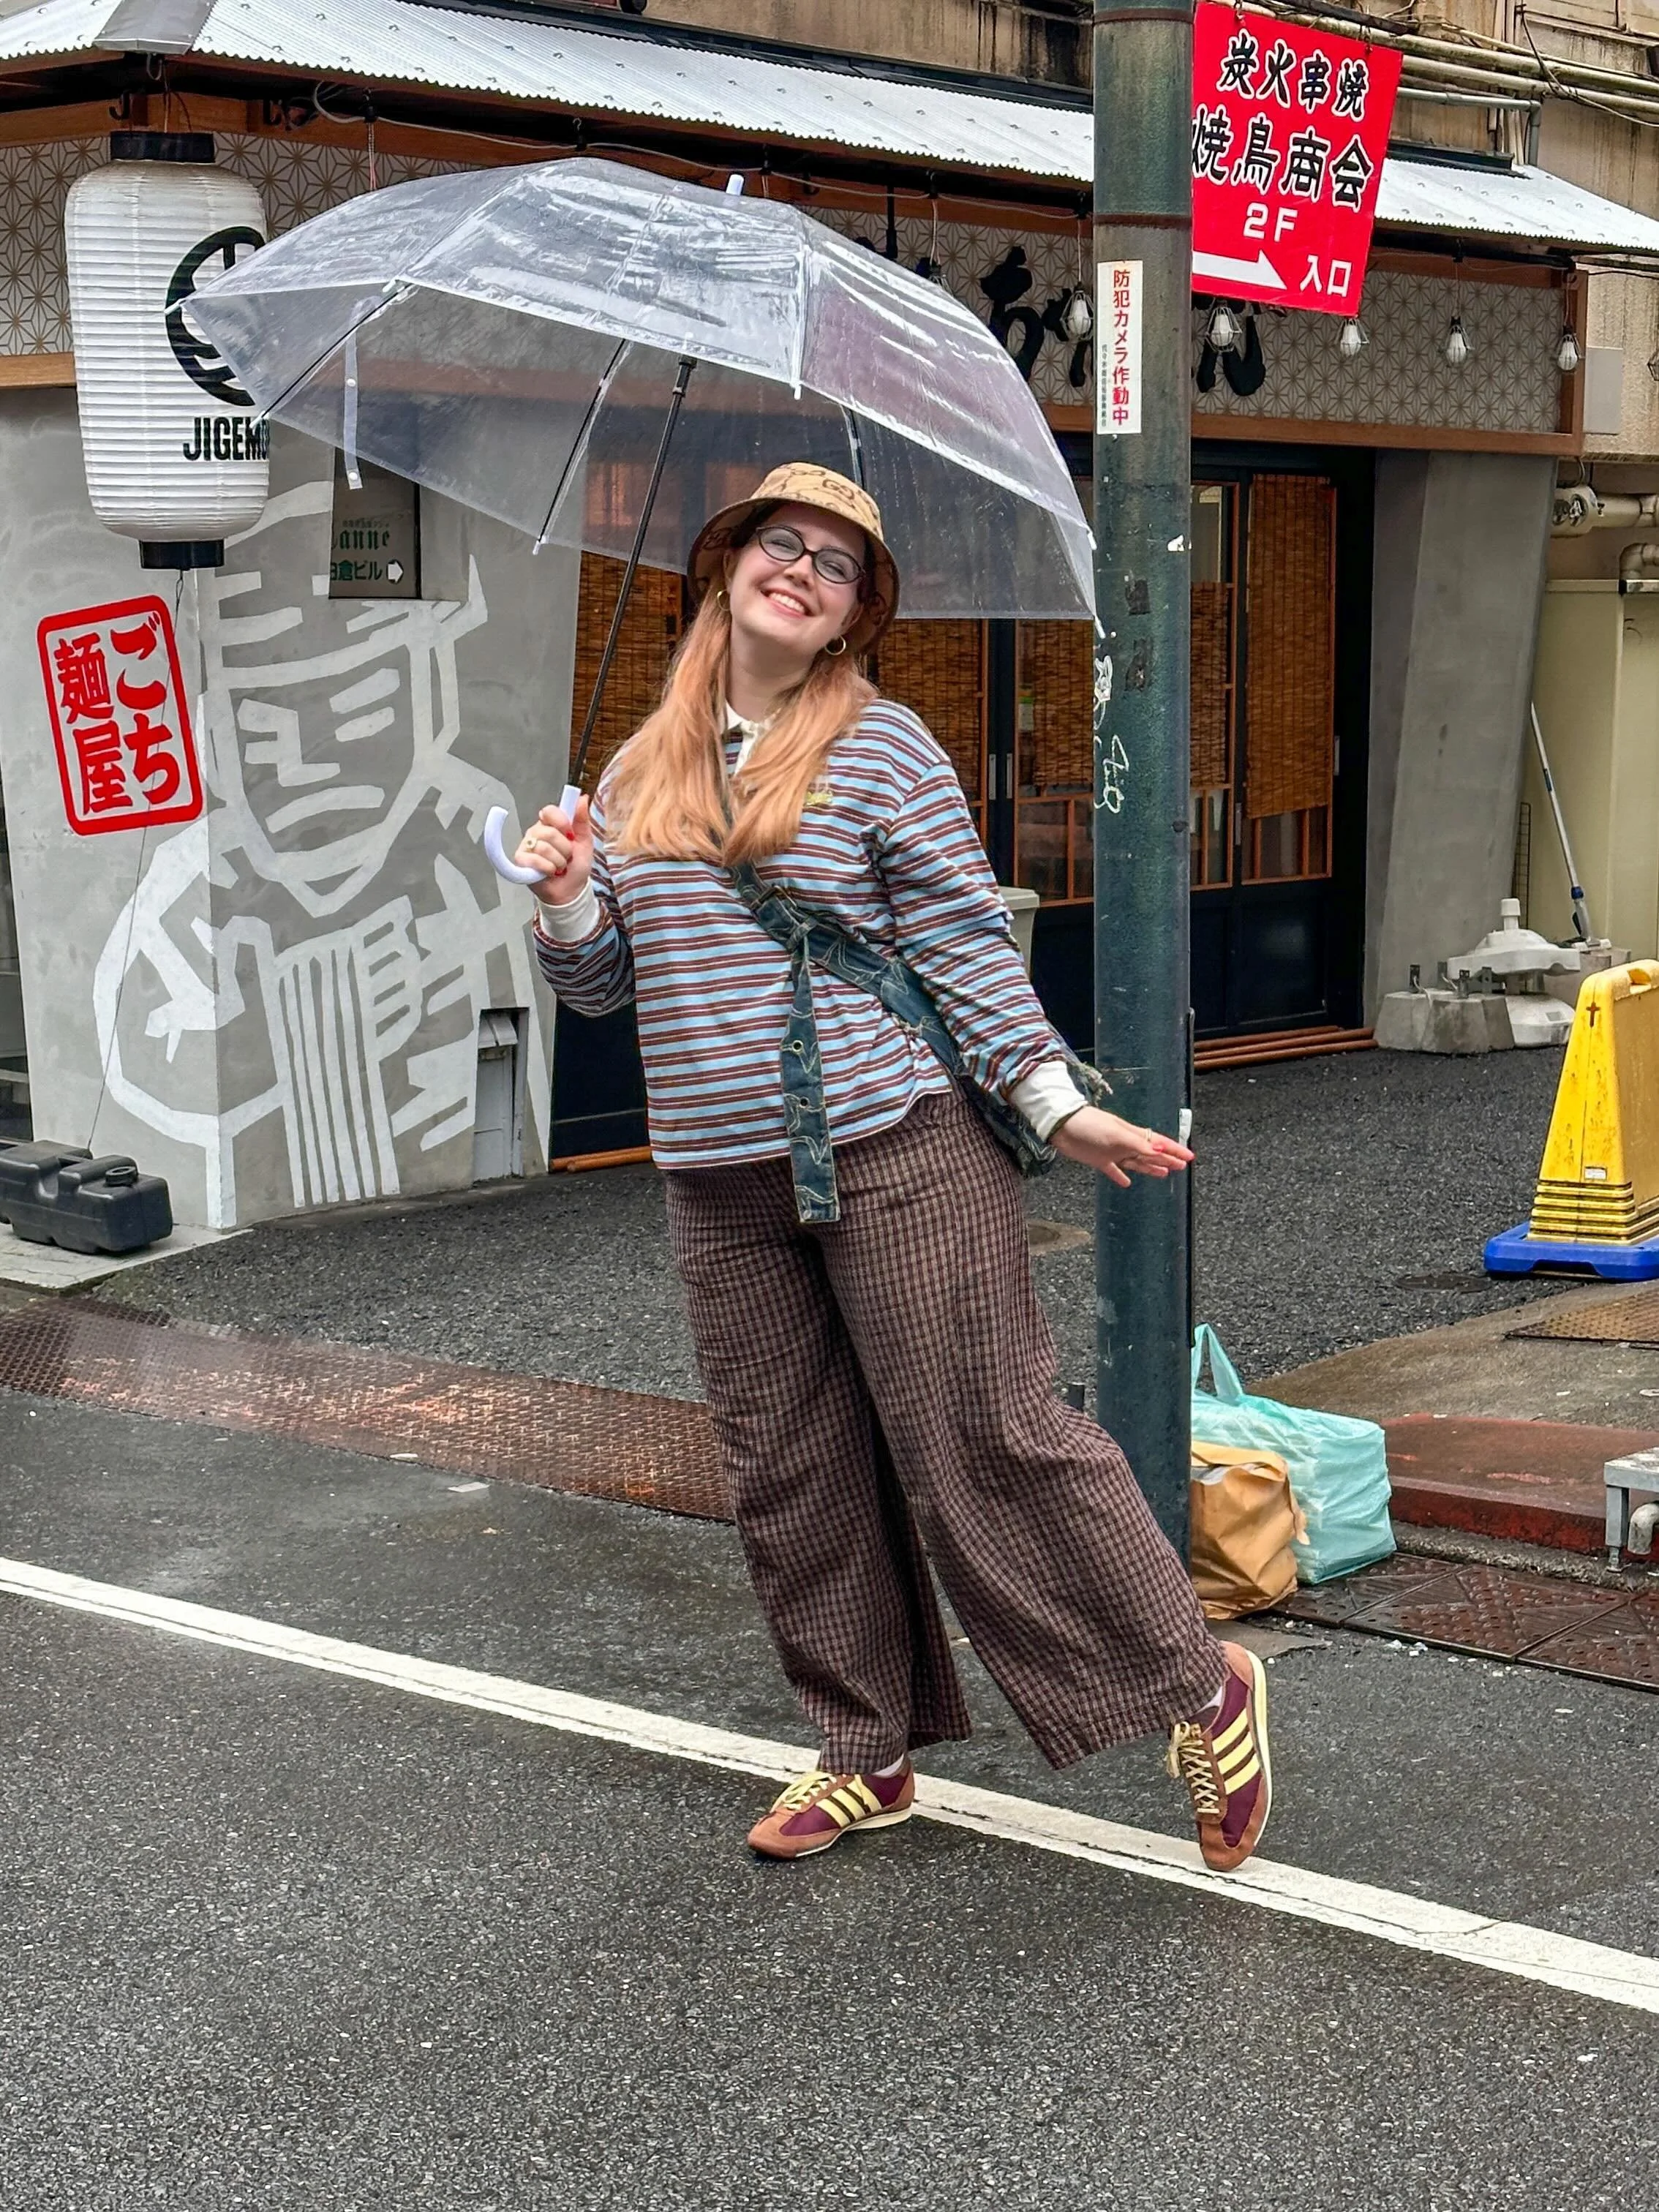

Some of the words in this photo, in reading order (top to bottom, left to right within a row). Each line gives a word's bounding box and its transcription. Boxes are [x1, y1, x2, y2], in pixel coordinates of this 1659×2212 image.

[1217, 31, 1368, 120] 炭火串焼
[1192, 104, 1373, 212] 焼鳥商会
[1244, 203, 1298, 242] 2F
[1299, 254, 1353, 297] 入口
[1112, 269, 1131, 426] 防犯カメラ作動中
[331, 529, 390, 550] anne
